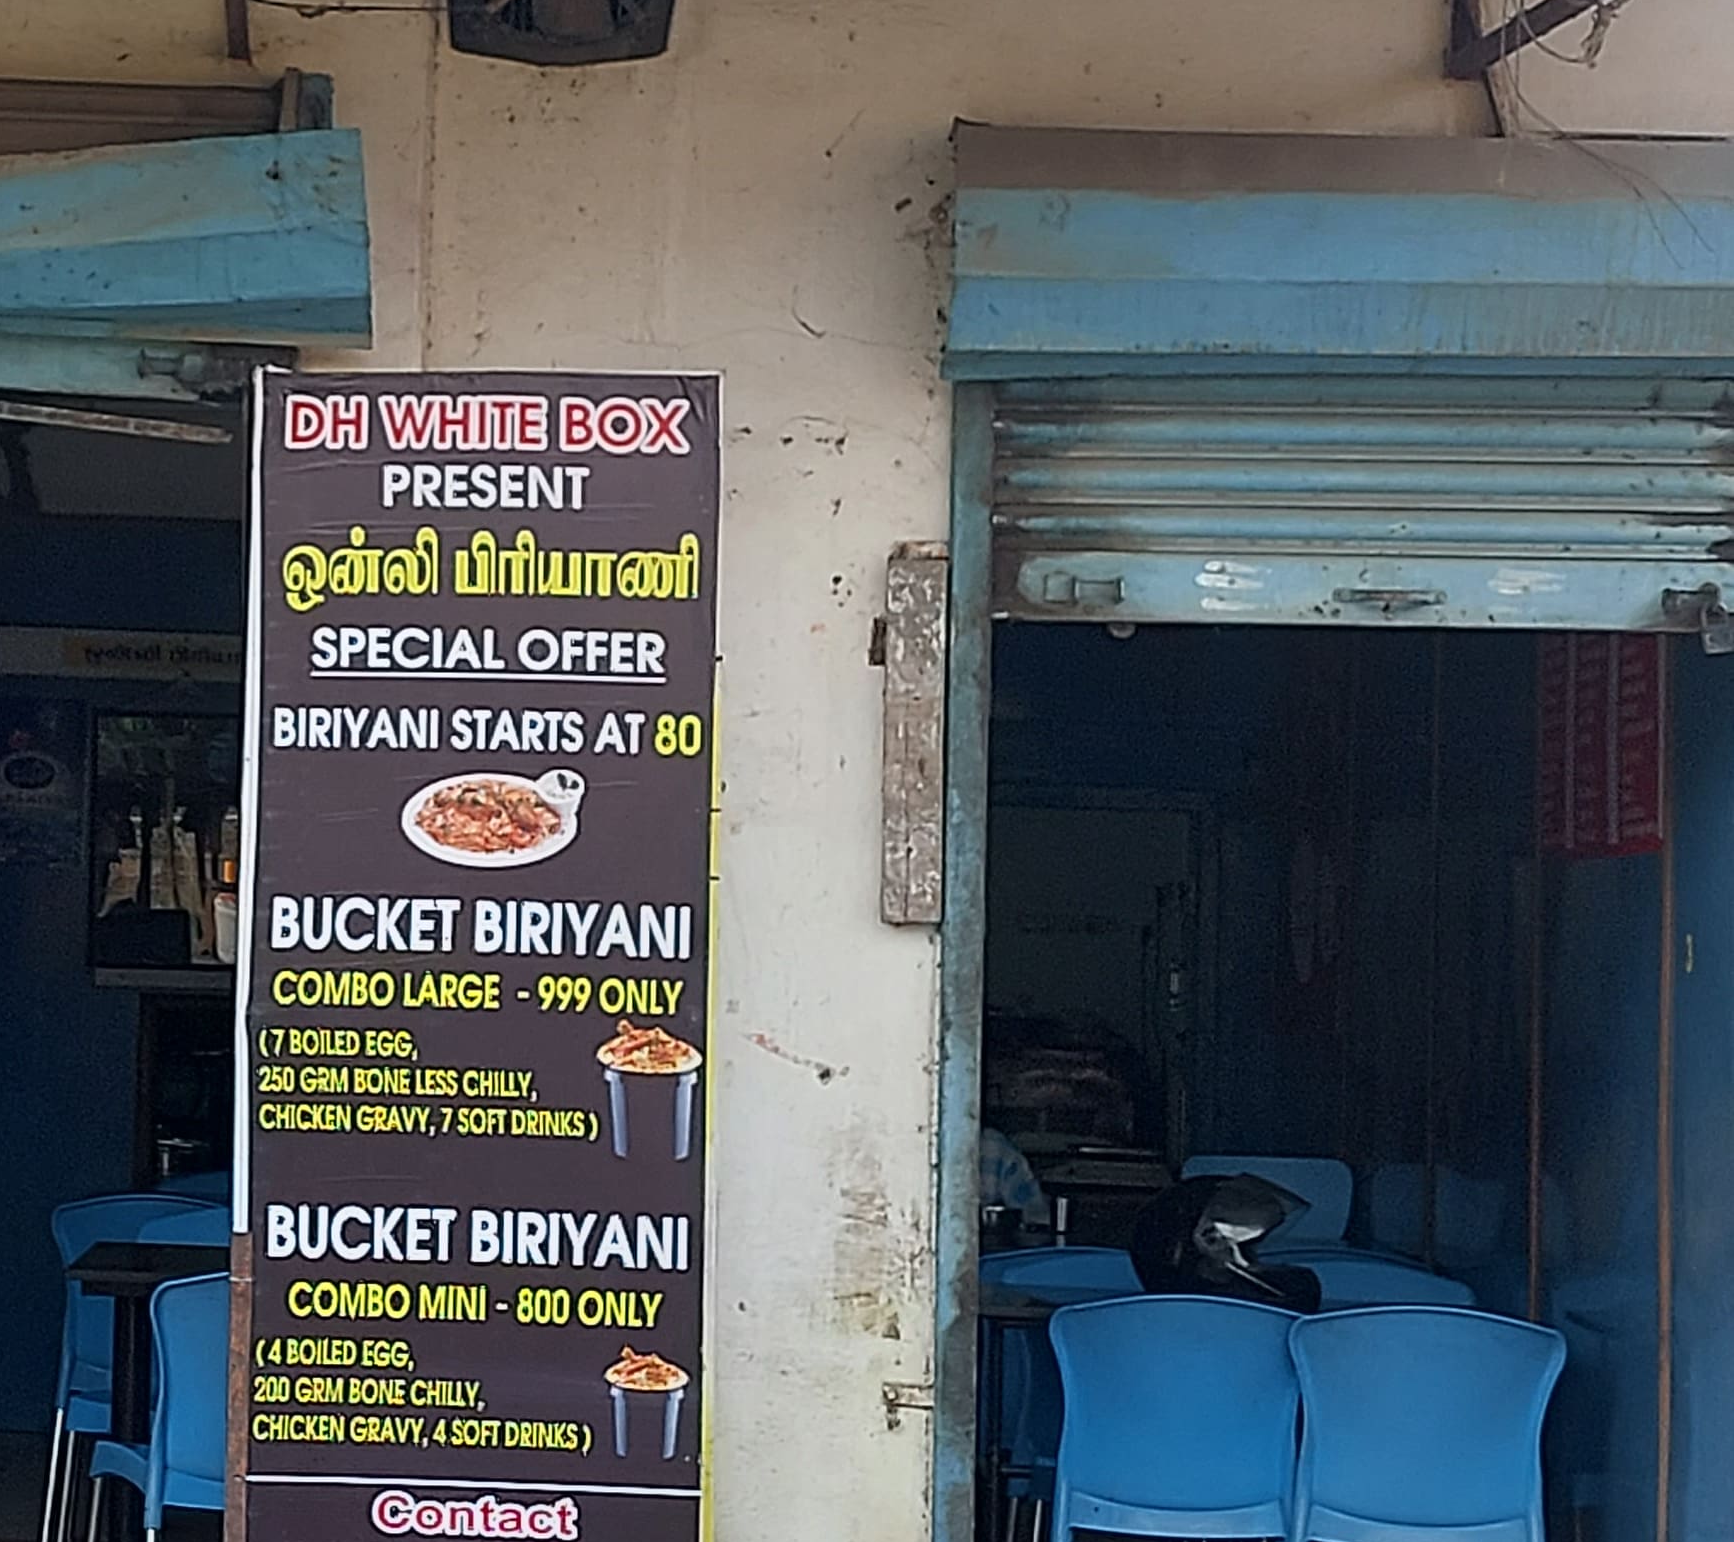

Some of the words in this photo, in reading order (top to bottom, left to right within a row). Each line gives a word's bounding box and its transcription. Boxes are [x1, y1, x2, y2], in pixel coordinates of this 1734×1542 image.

[285, 394, 368, 450] DH
[378, 394, 548, 452] WHITE
[558, 398, 691, 455] BOX
[382, 464, 590, 510] PRESENT
[283, 526, 438, 611] ஒன்லி
[455, 529, 699, 600] பிரியாணி
[311, 627, 506, 671] SPECIAL
[517, 630, 666, 674] OFFER
[273, 706, 439, 749] BIRIYANI
[449, 710, 583, 754] STARTS
[594, 713, 645, 754] AT
[654, 714, 701, 756] 80
[271, 896, 461, 953] BUCKET
[473, 900, 691, 959] BIRIYANI
[273, 970, 395, 1008] COMBO
[403, 972, 500, 1010] LARGE
[538, 976, 591, 1012] 999
[598, 979, 683, 1016] ONLY
[290, 1030, 360, 1057] BOILED
[365, 1031, 418, 1061] EGG,
[258, 1066, 295, 1092] 250
[299, 1066, 348, 1094] GRM
[353, 1068, 410, 1095] BONE
[415, 1069, 458, 1096] LESS
[462, 1070, 538, 1102] CHILLY,
[259, 1104, 351, 1132] CHICKEN
[356, 1105, 435, 1137] GRAVY,
[440, 1107, 453, 1133] 7
[457, 1108, 506, 1136] SOFT
[266, 1204, 457, 1262] BUCKET
[470, 1210, 689, 1271] BIRIYANI
[288, 1281, 411, 1319] COMBO
[418, 1284, 487, 1322] MINI
[515, 1287, 570, 1325] 800
[577, 1290, 664, 1328] ONLY
[286, 1339, 357, 1366] BOILED
[362, 1340, 415, 1372] EGG,
[253, 1375, 291, 1403] 200
[294, 1376, 343, 1404] GRM
[348, 1377, 407, 1405] BONE
[409, 1379, 486, 1412] CHILLY,
[251, 1414, 345, 1442] CHICKEN
[349, 1414, 429, 1449] GRAVY,
[432, 1418, 447, 1443] 4
[451, 1418, 502, 1448] SOFT
[371, 1490, 579, 1541] Contact
